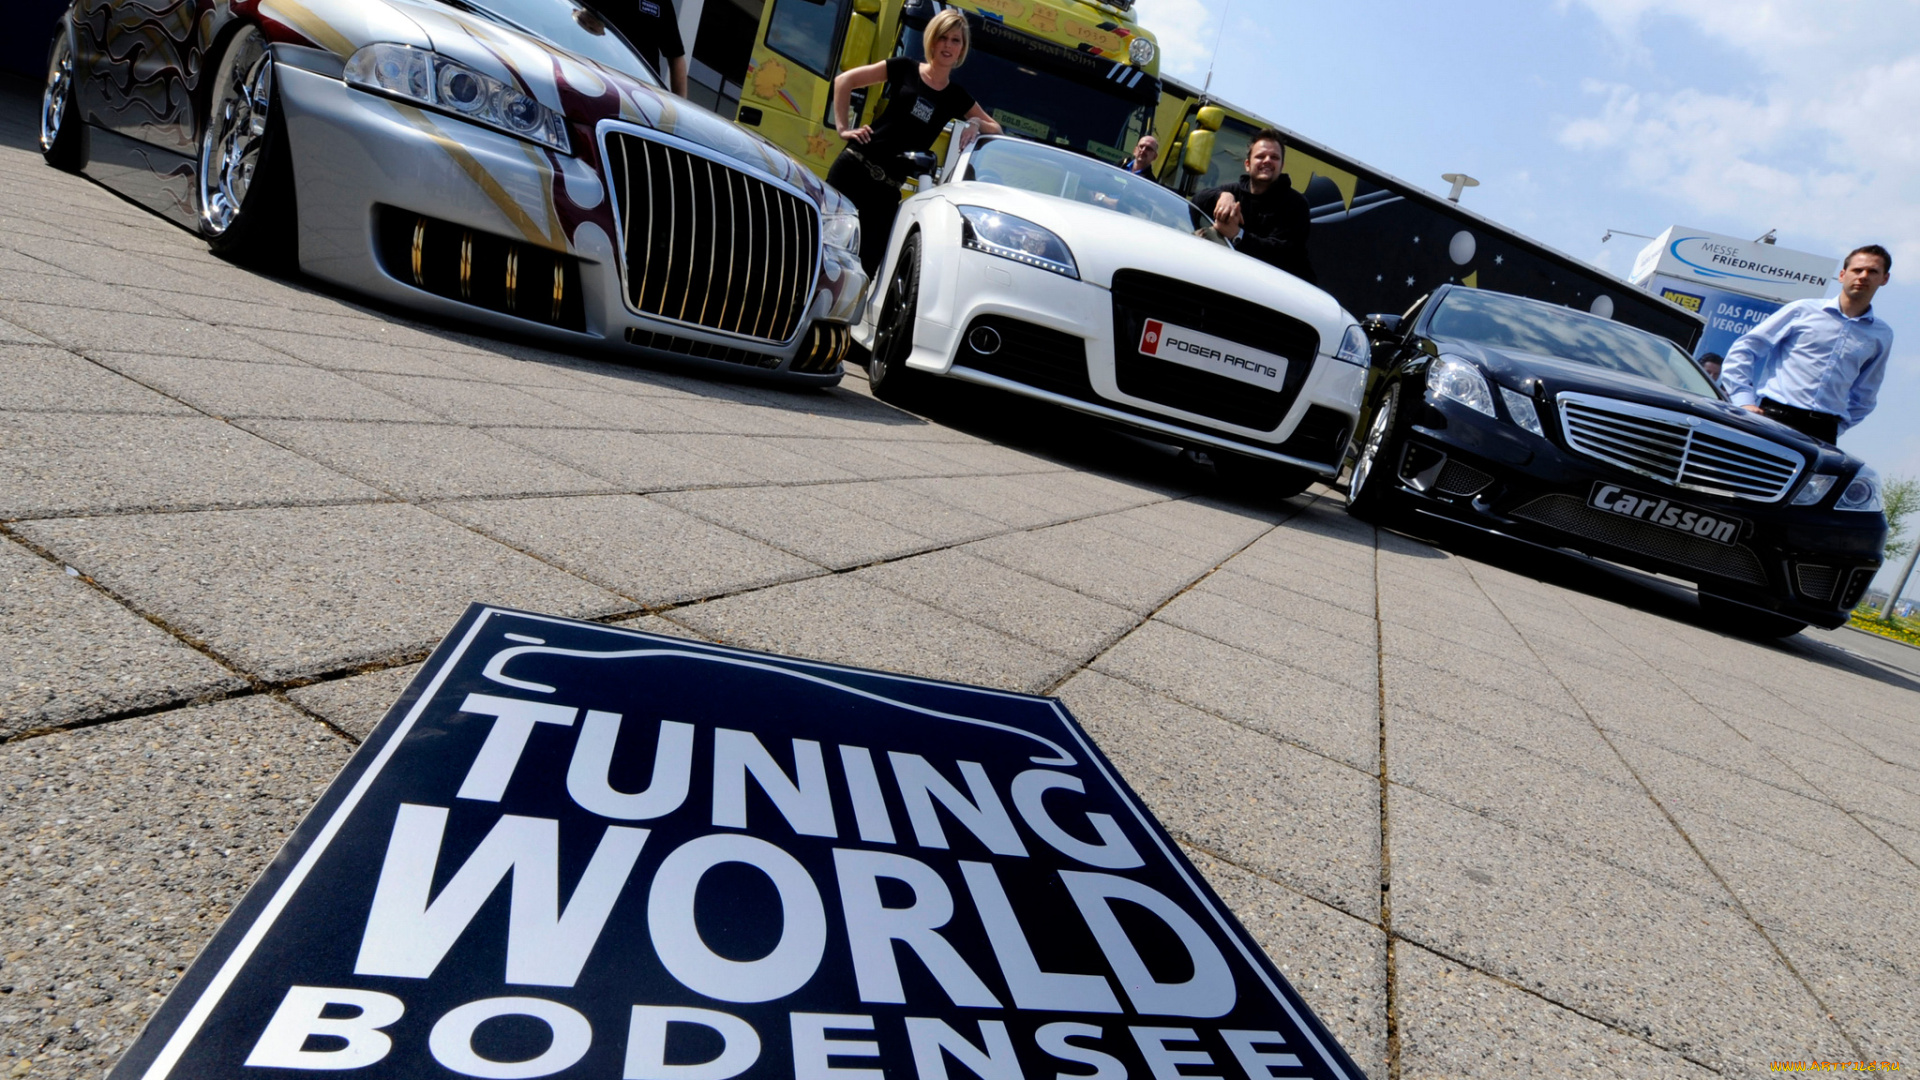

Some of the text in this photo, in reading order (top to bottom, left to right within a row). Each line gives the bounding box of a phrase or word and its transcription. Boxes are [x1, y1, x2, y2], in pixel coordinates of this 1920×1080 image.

[1701, 242, 1740, 258] MESSE
[1712, 254, 1828, 287] FRIEDRICHSHAFEN
[1663, 290, 1702, 308] INTER
[1717, 303, 1742, 318] DAS
[1223, 354, 1278, 379] RACING
[1593, 485, 1736, 543] Carlsson
[457, 692, 1147, 870] TUNING
[353, 802, 1237, 1018] WORLD
[243, 985, 1314, 1080] BODENSEE
